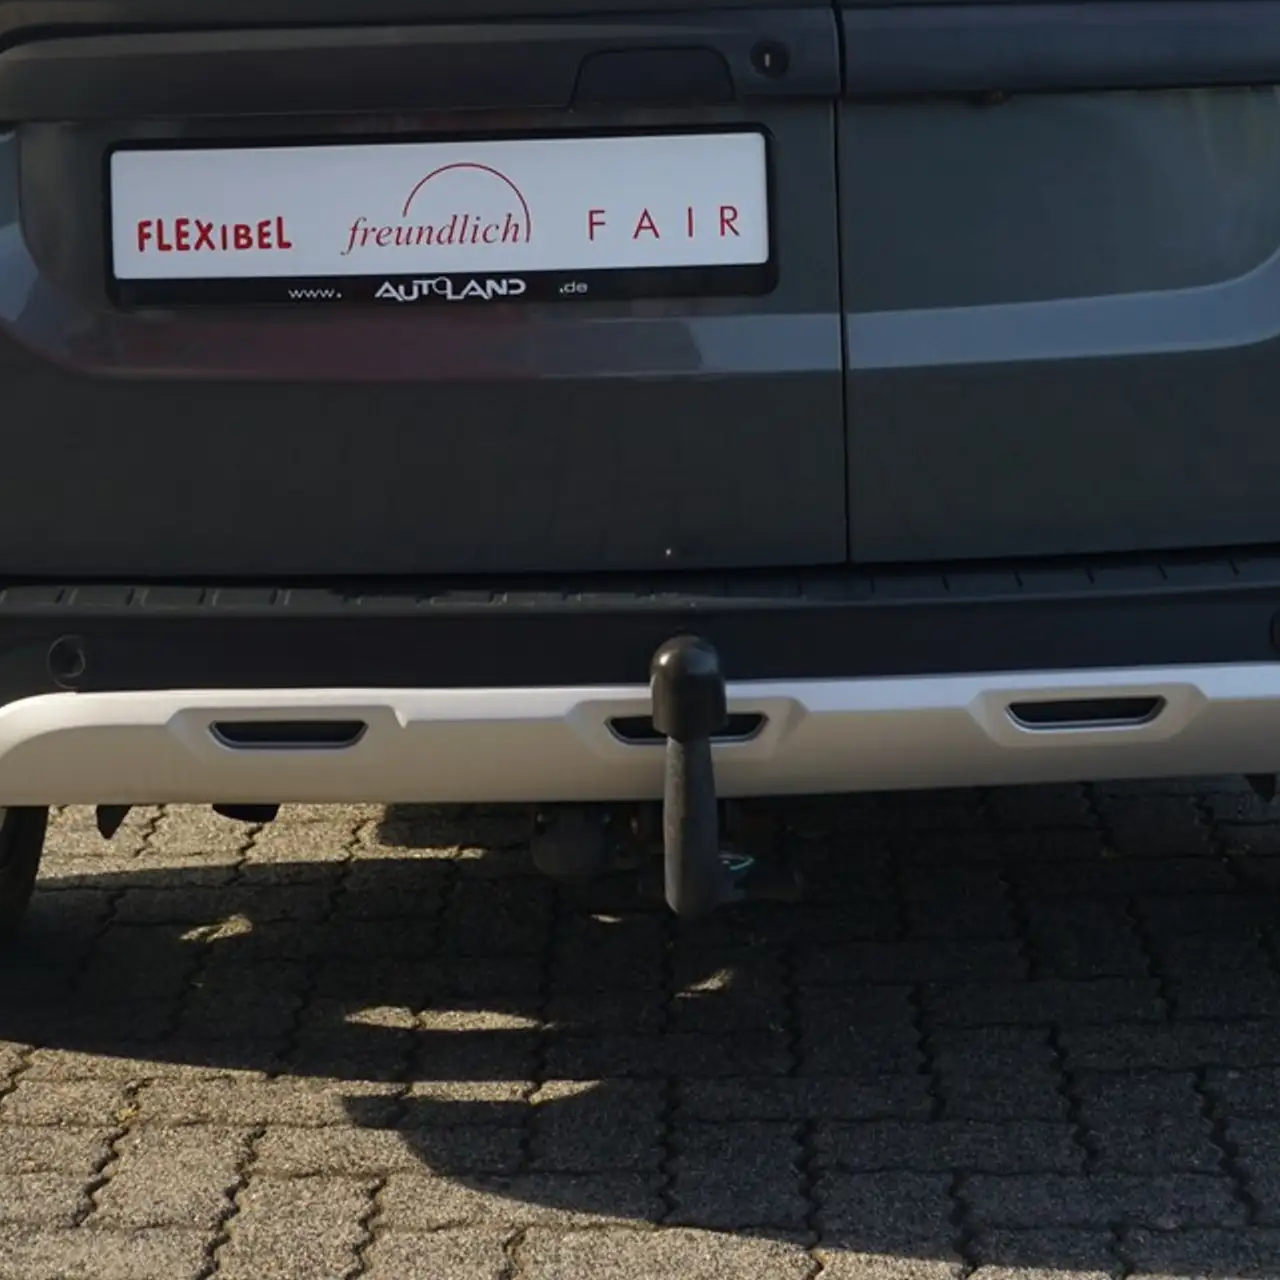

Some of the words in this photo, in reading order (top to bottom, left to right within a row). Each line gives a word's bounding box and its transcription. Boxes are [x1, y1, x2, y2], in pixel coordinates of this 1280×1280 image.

[137, 216, 293, 253] FLEXIBEL
[340, 213, 520, 256] freundlich
[287, 287, 343, 300] www.
[374, 276, 527, 302] AUTOLAND
